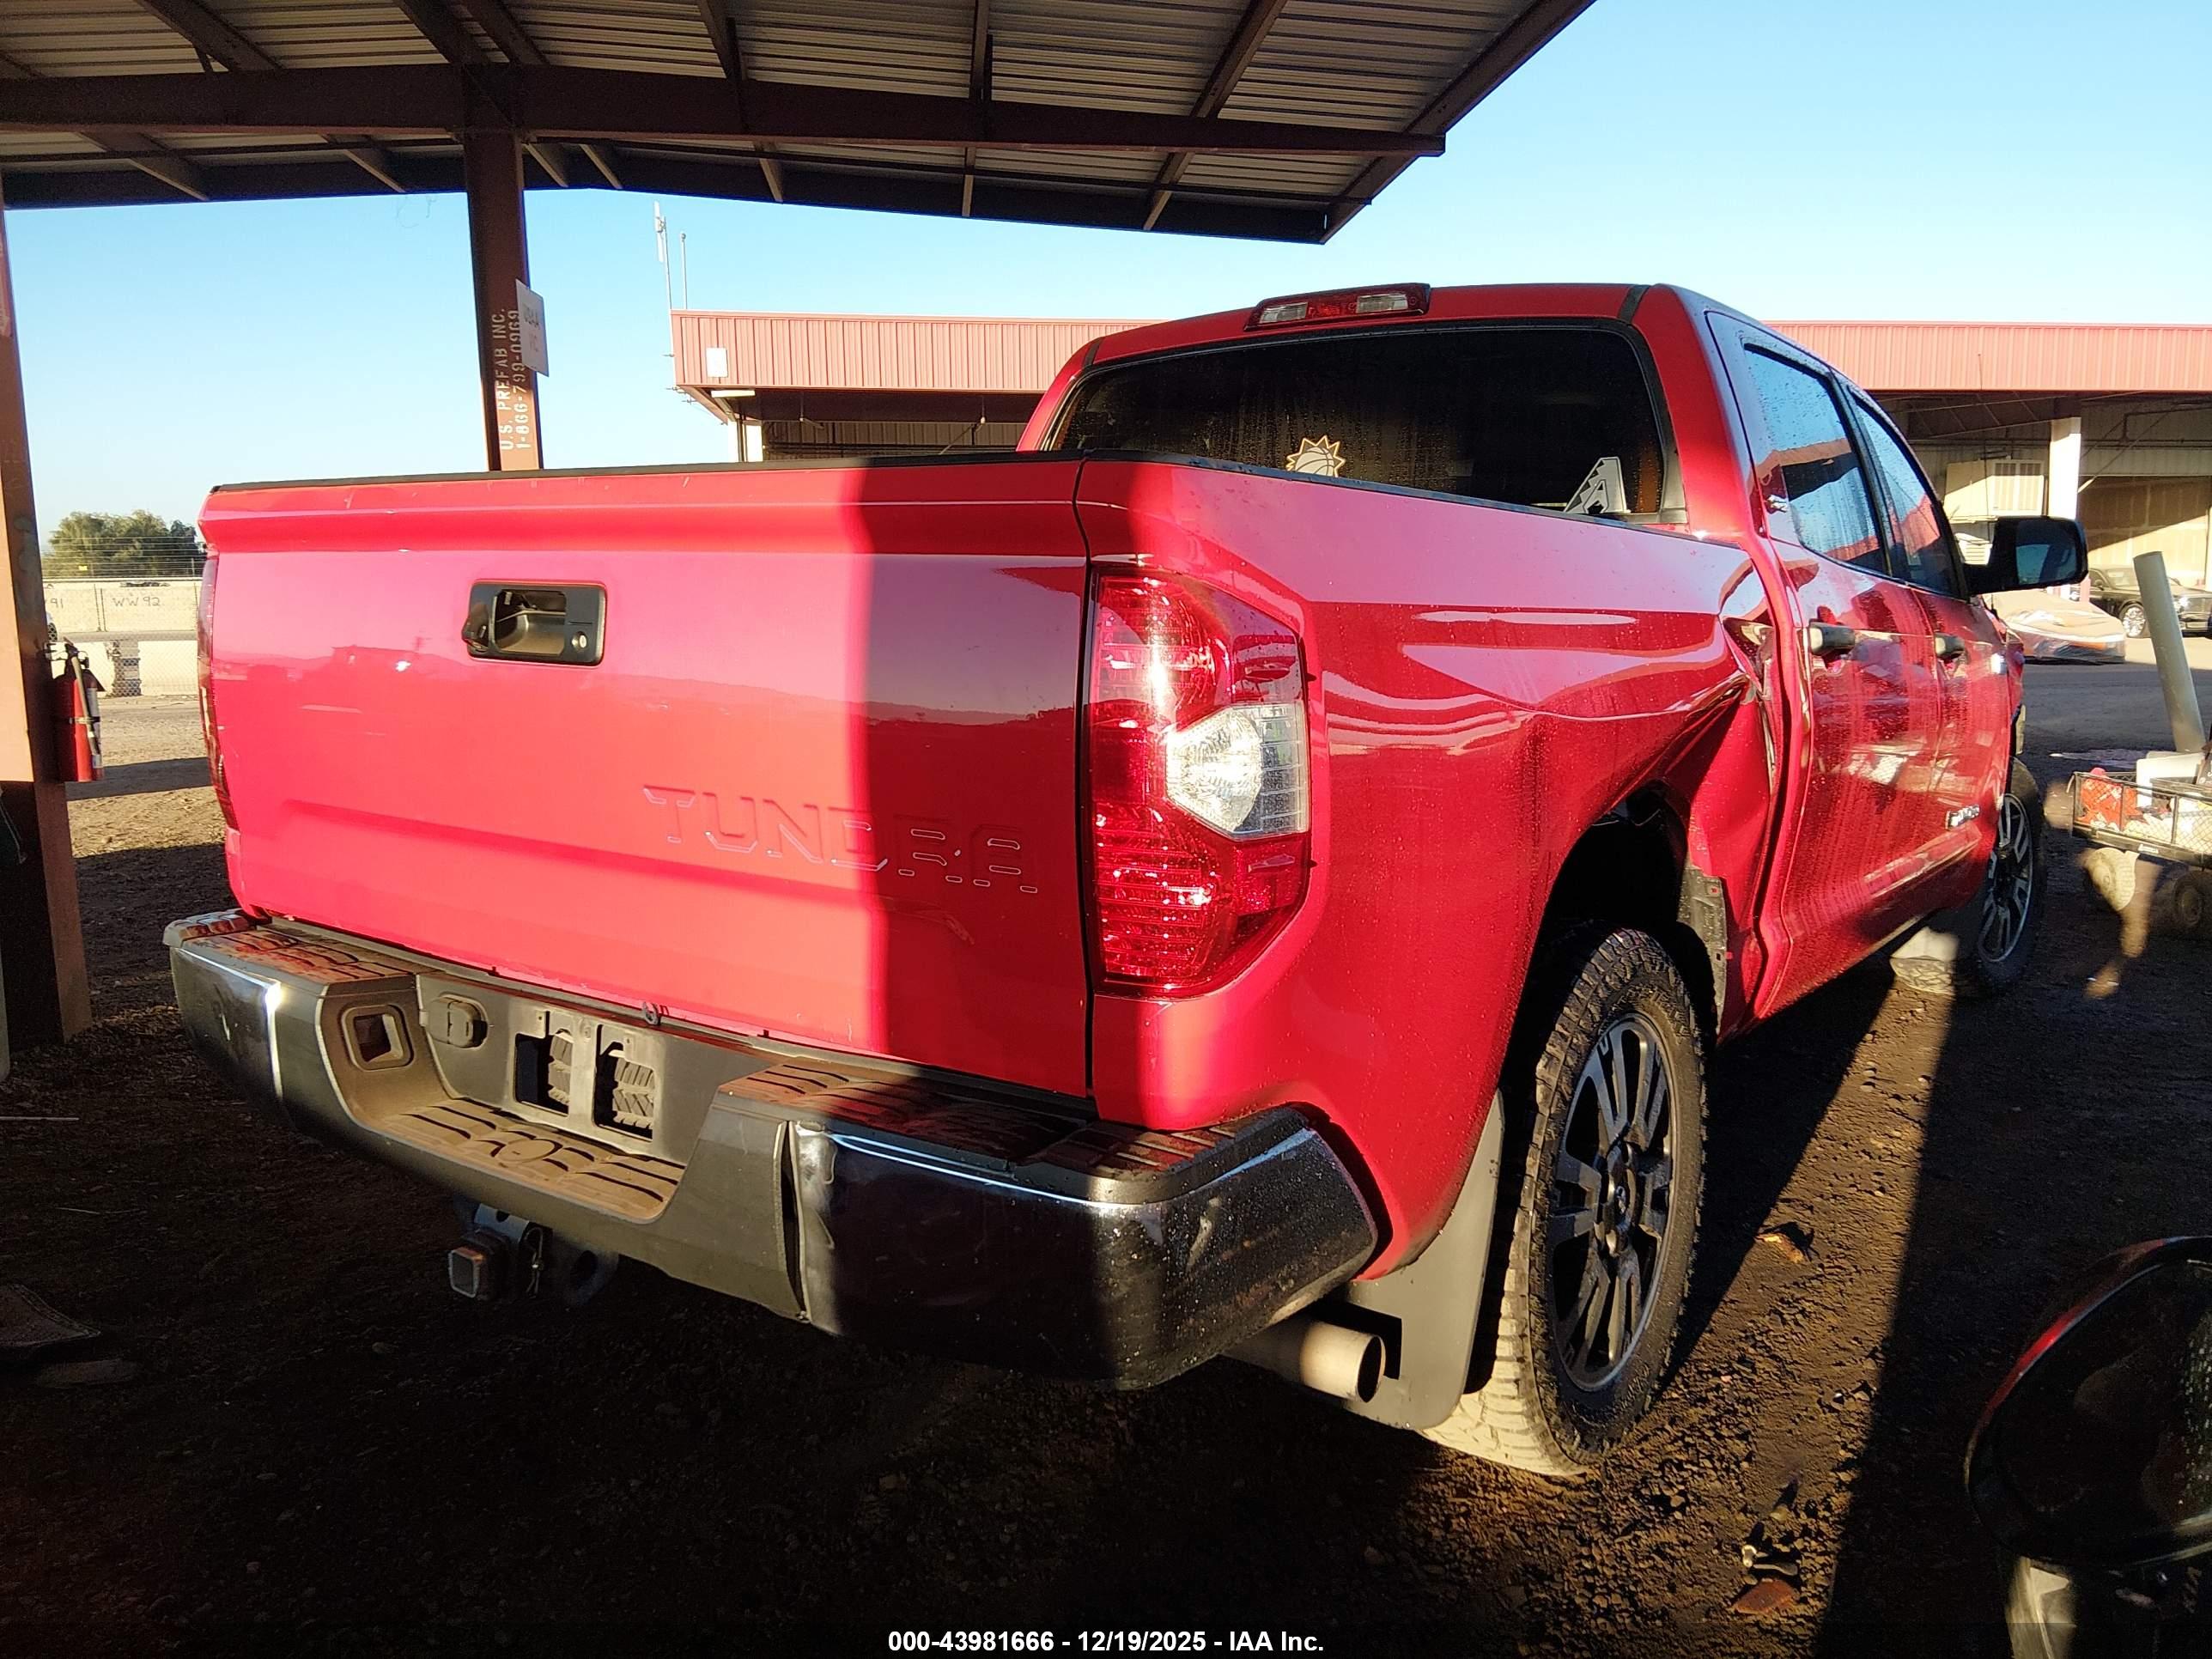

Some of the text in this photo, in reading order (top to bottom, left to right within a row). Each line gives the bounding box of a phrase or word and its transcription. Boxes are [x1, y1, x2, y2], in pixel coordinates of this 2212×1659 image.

[491, 308, 514, 451] U.S. PREFAB INC.
[643, 784, 1039, 894] TUNDRA
